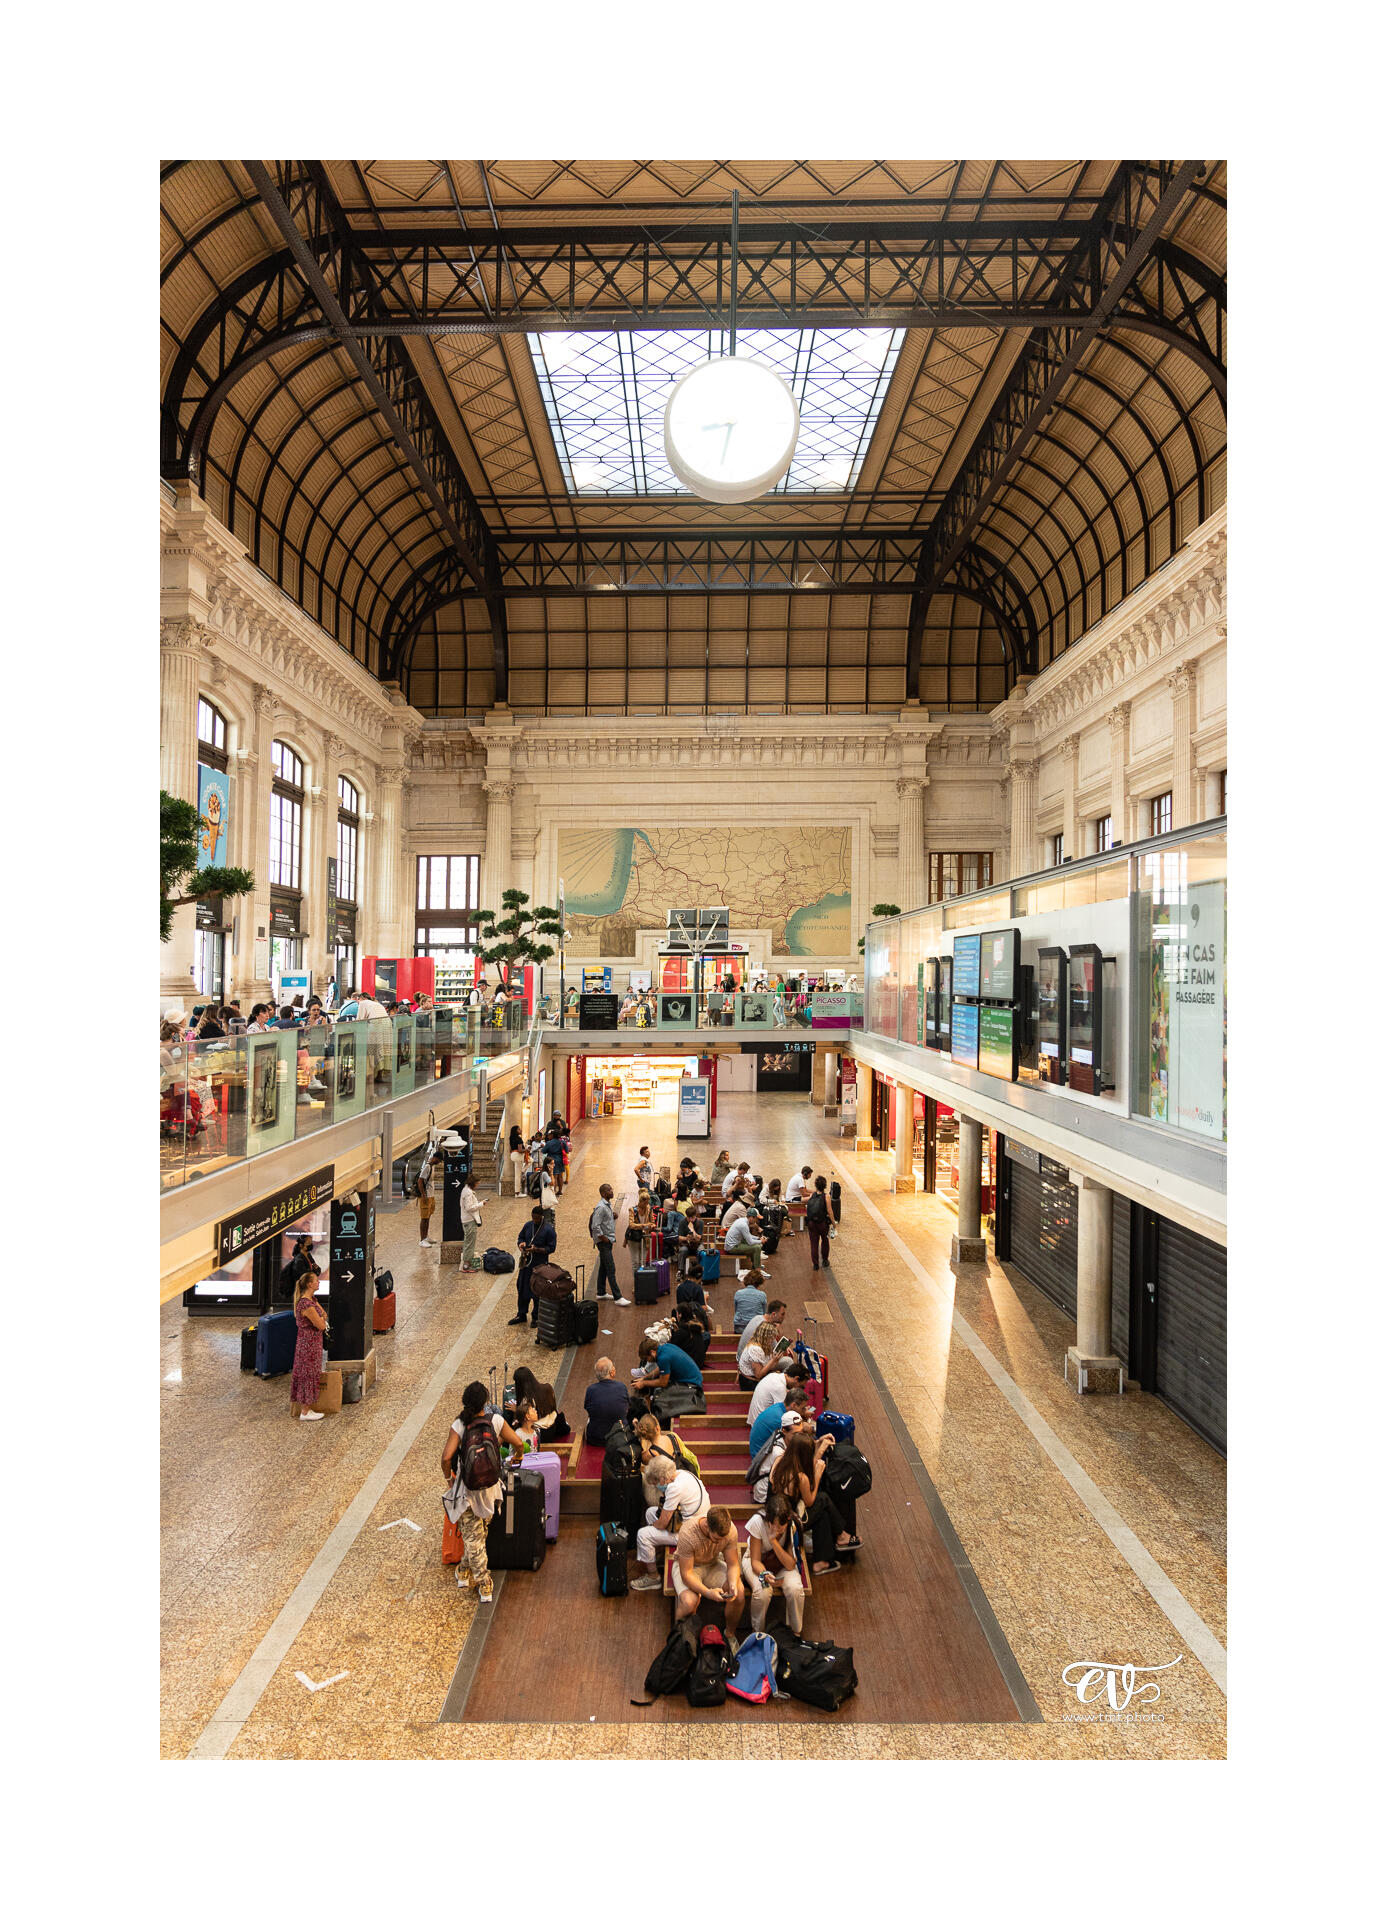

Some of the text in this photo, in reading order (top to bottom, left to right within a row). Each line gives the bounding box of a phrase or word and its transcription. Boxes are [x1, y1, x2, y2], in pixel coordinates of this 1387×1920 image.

[1193, 944, 1216, 962] CAS
[1191, 968, 1216, 985] FAIM
[243, 1224, 256, 1237] Sortie
[336, 1252, 341, 1260] 1
[354, 1251, 364, 1259] 14
